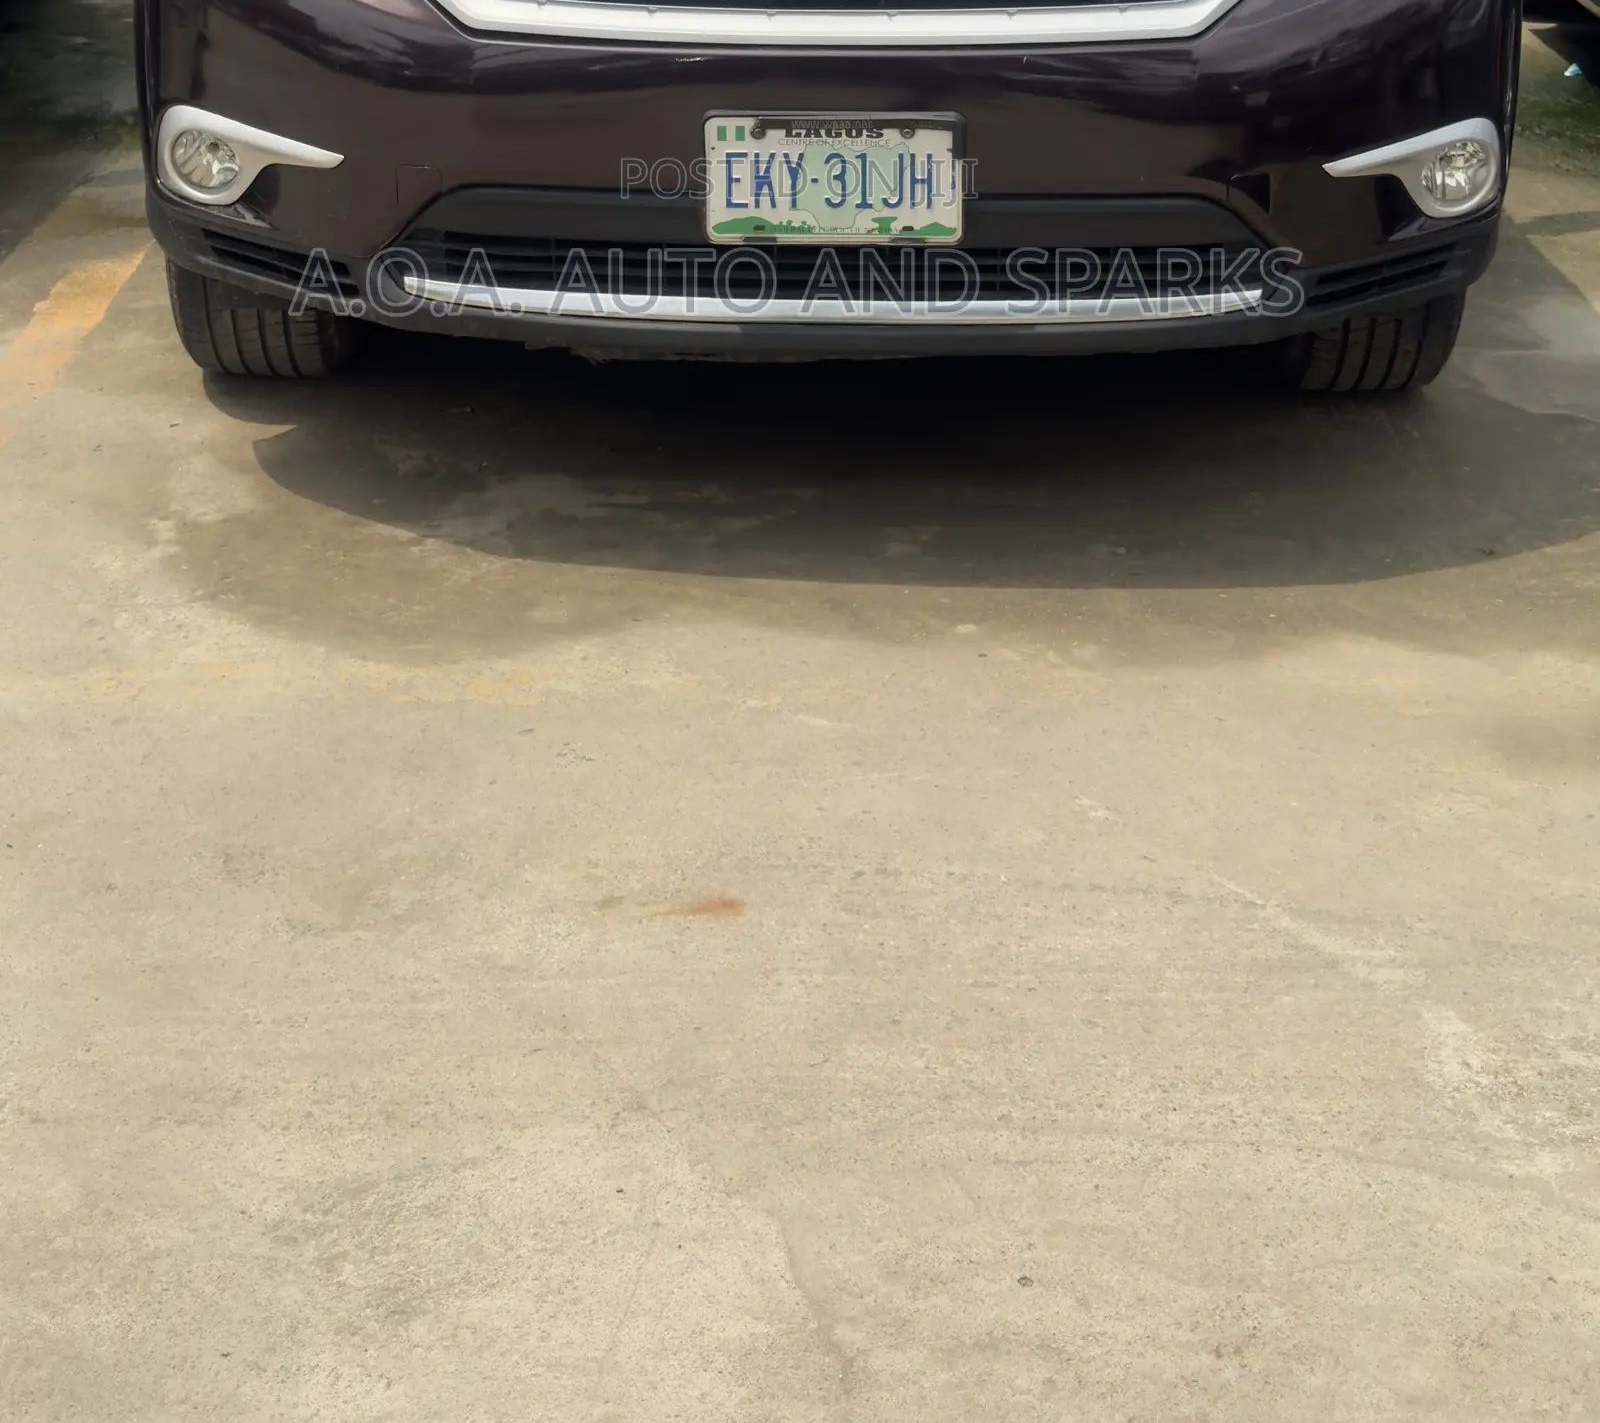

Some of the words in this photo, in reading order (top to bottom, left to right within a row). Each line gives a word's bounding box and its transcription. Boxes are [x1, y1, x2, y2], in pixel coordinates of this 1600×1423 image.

[777, 139, 814, 147] CENTRE
[816, 139, 829, 147] OF
[831, 139, 891, 147] EXCELLENCE
